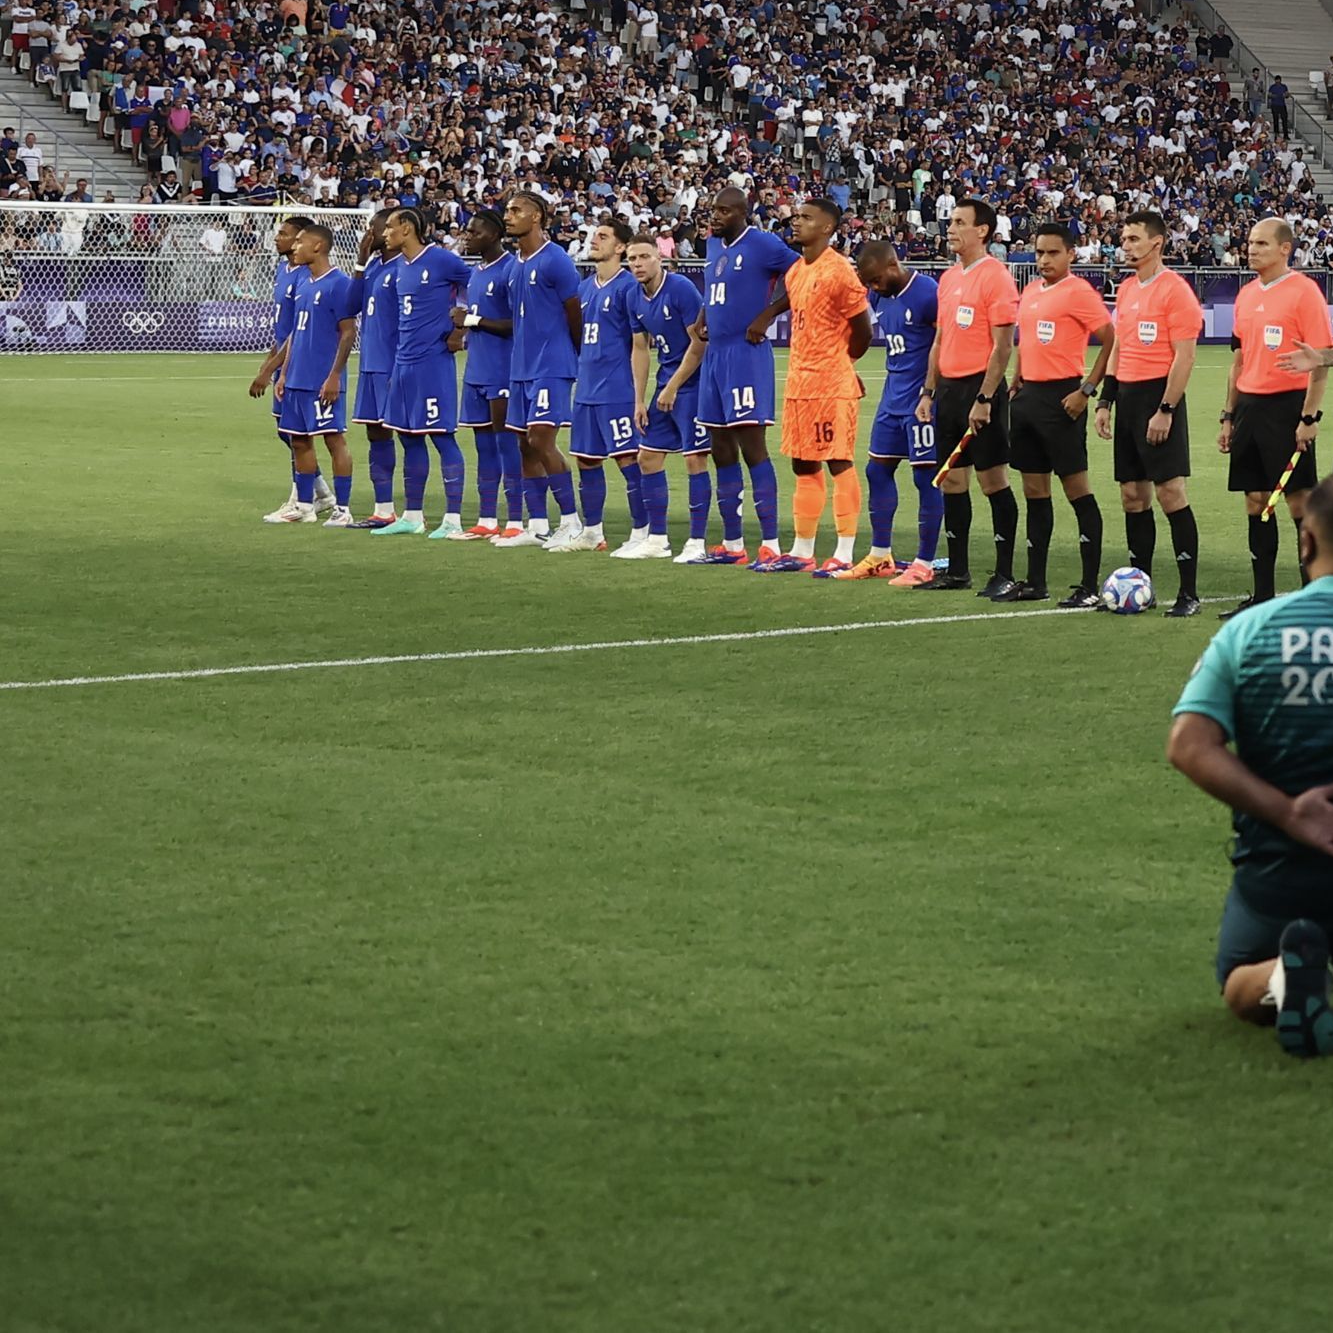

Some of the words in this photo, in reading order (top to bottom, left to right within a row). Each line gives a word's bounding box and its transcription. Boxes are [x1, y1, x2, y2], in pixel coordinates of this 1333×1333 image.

[709, 282, 726, 306] 14
[366, 296, 375, 316] 6
[402, 295, 413, 316] 5
[958, 307, 972, 315] FIFA
[583, 322, 598, 345] 13
[1039, 322, 1053, 330] FIFA
[1139, 322, 1155, 331] FIFA
[1265, 327, 1281, 335] FIFA
[886, 334, 906, 356] 10
[426, 397, 439, 418] 5
[537, 388, 550, 410] 4
[731, 386, 755, 410] 14
[313, 399, 334, 420] 12
[609, 416, 633, 441] 13
[814, 421, 834, 443] 16
[912, 424, 935, 448] 10
